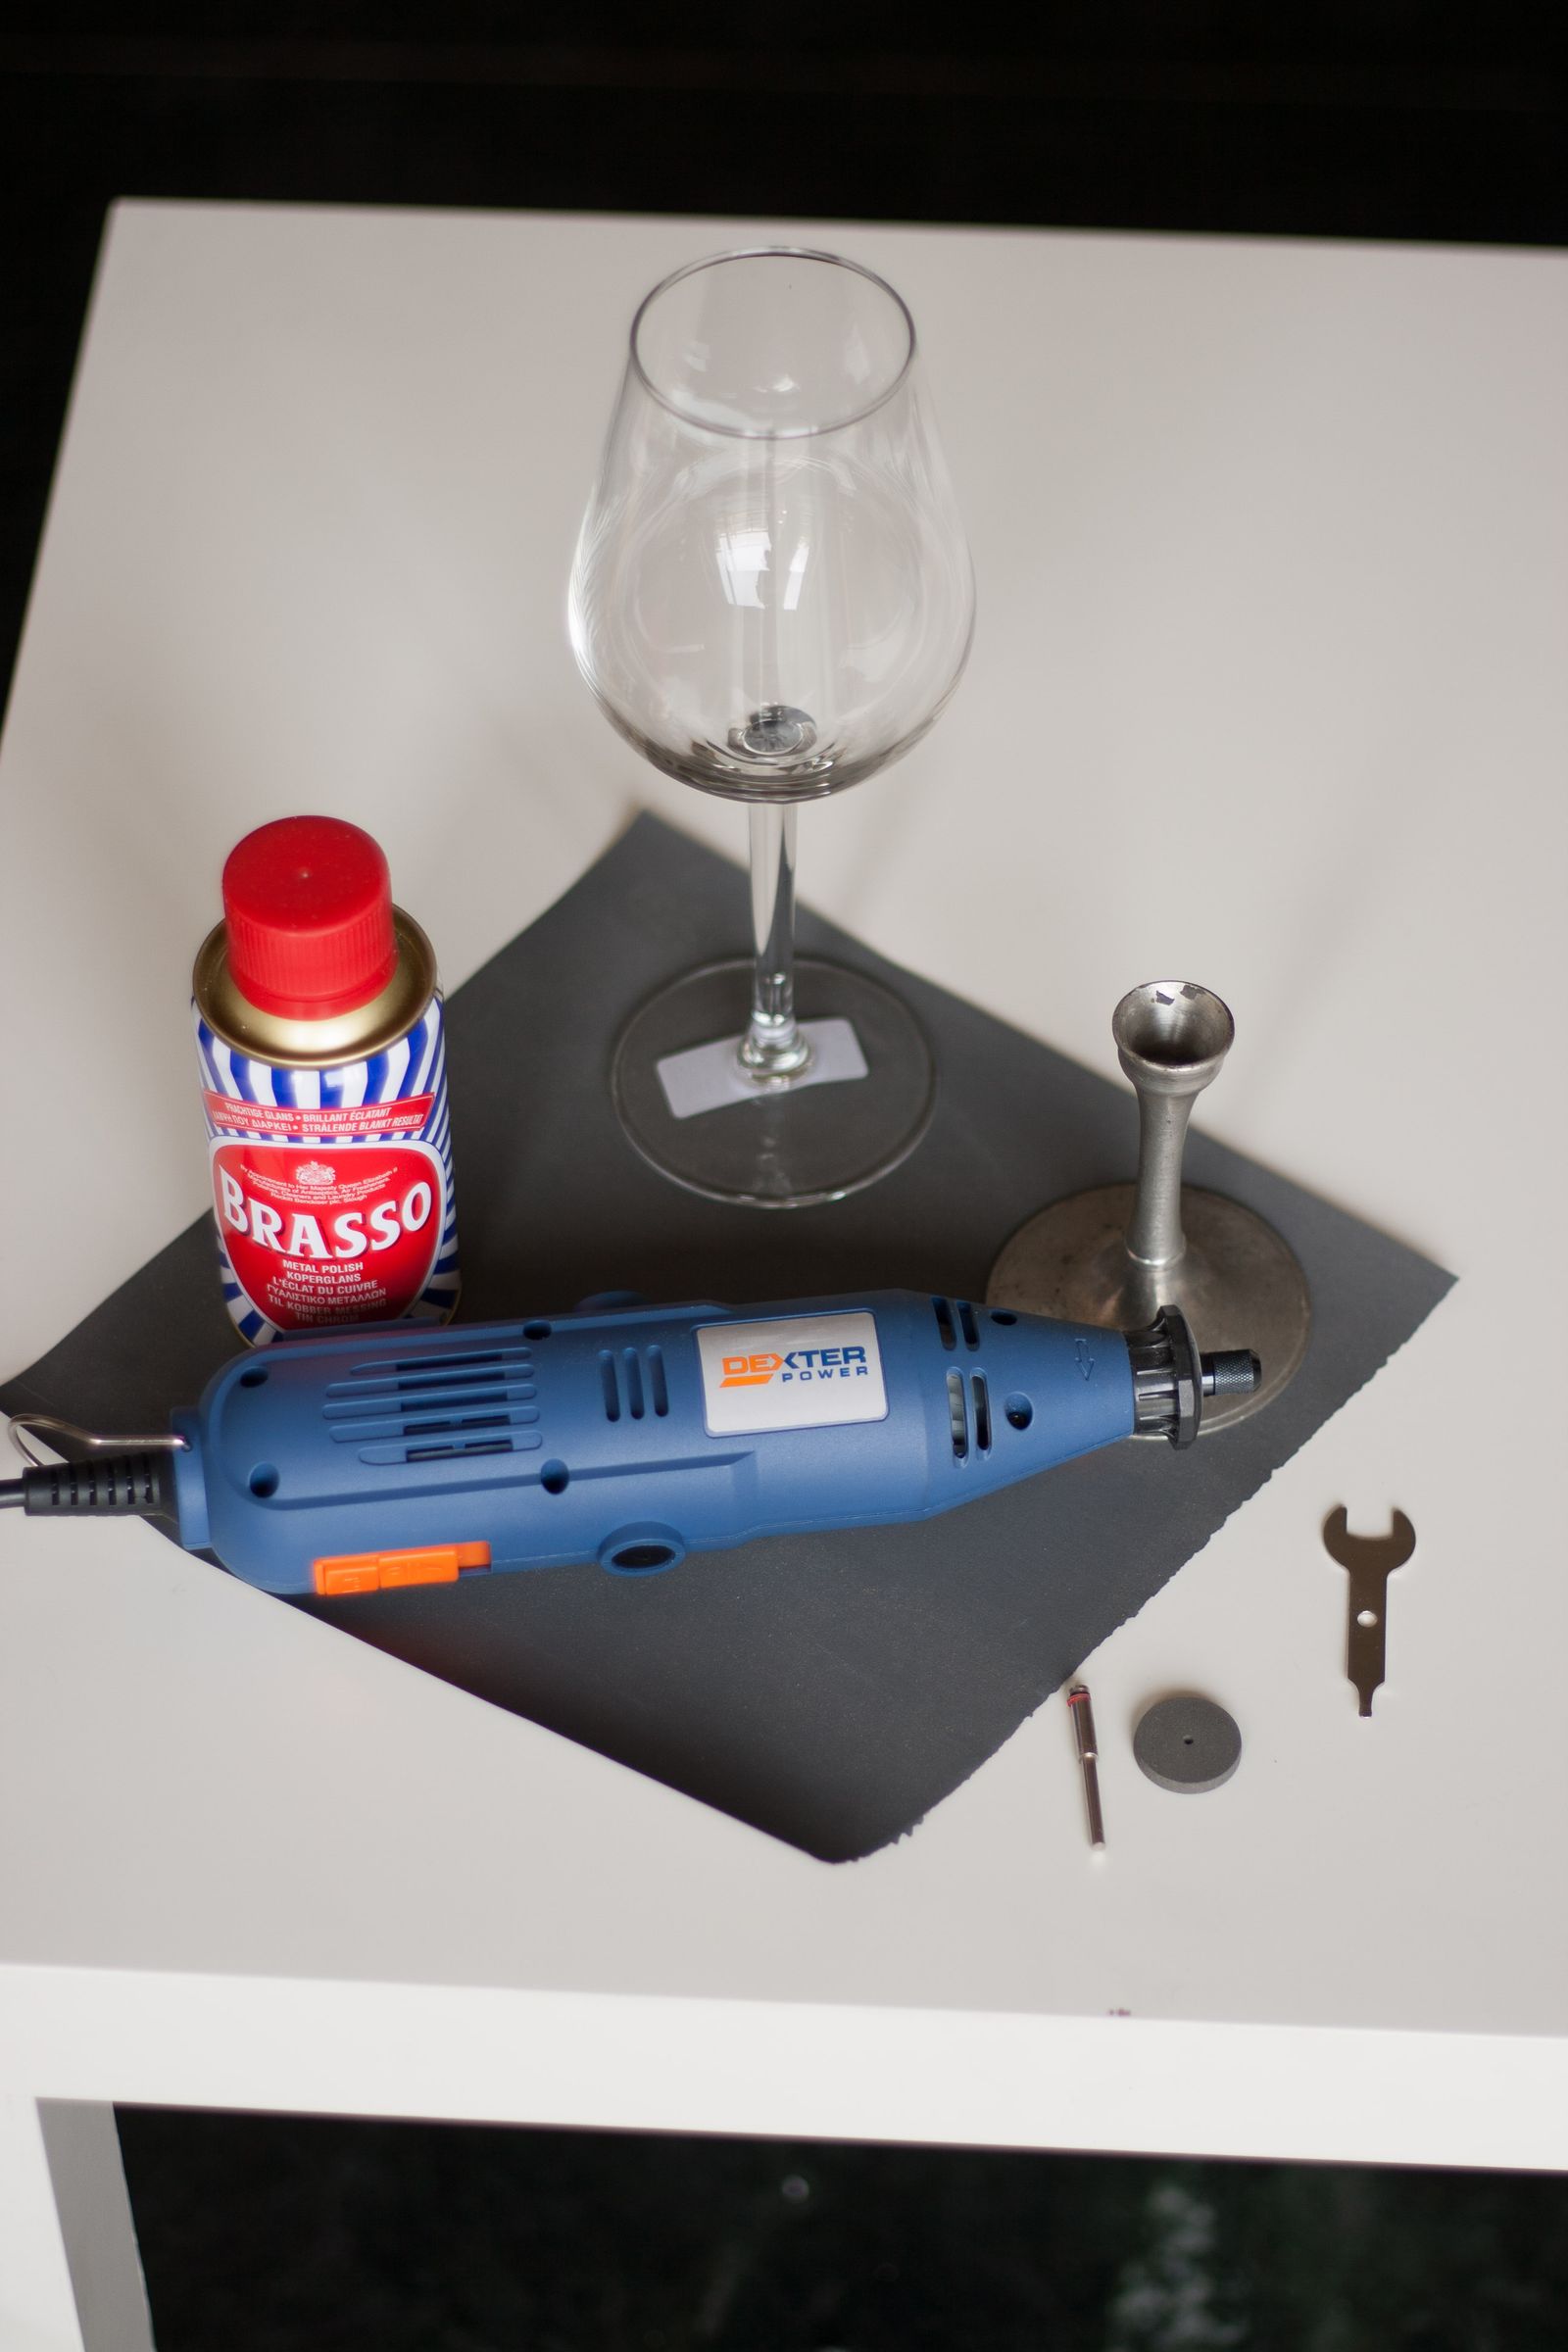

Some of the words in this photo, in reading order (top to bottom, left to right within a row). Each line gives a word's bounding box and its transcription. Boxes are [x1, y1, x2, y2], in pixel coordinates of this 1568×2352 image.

[265, 1110, 295, 1122] GLANS
[302, 1112, 349, 1123] BRILLANT
[350, 1106, 392, 1121] ÉCLATANT
[359, 1117, 394, 1131] BLANKT
[392, 1113, 424, 1127] RESULTAT
[219, 1163, 432, 1259] BRASSO
[281, 1258, 319, 1274] METAL
[321, 1261, 364, 1274] POLISH
[272, 1276, 315, 1294] L'ÉCLAT
[318, 1286, 334, 1295] DU
[337, 1279, 378, 1295] CUIVRE
[286, 1270, 362, 1285] KOPERGLANS
[268, 1294, 284, 1307] TIL
[334, 1298, 388, 1315] MESSING
[721, 1346, 867, 1376] DEXTER
[781, 1365, 869, 1383] POWER
